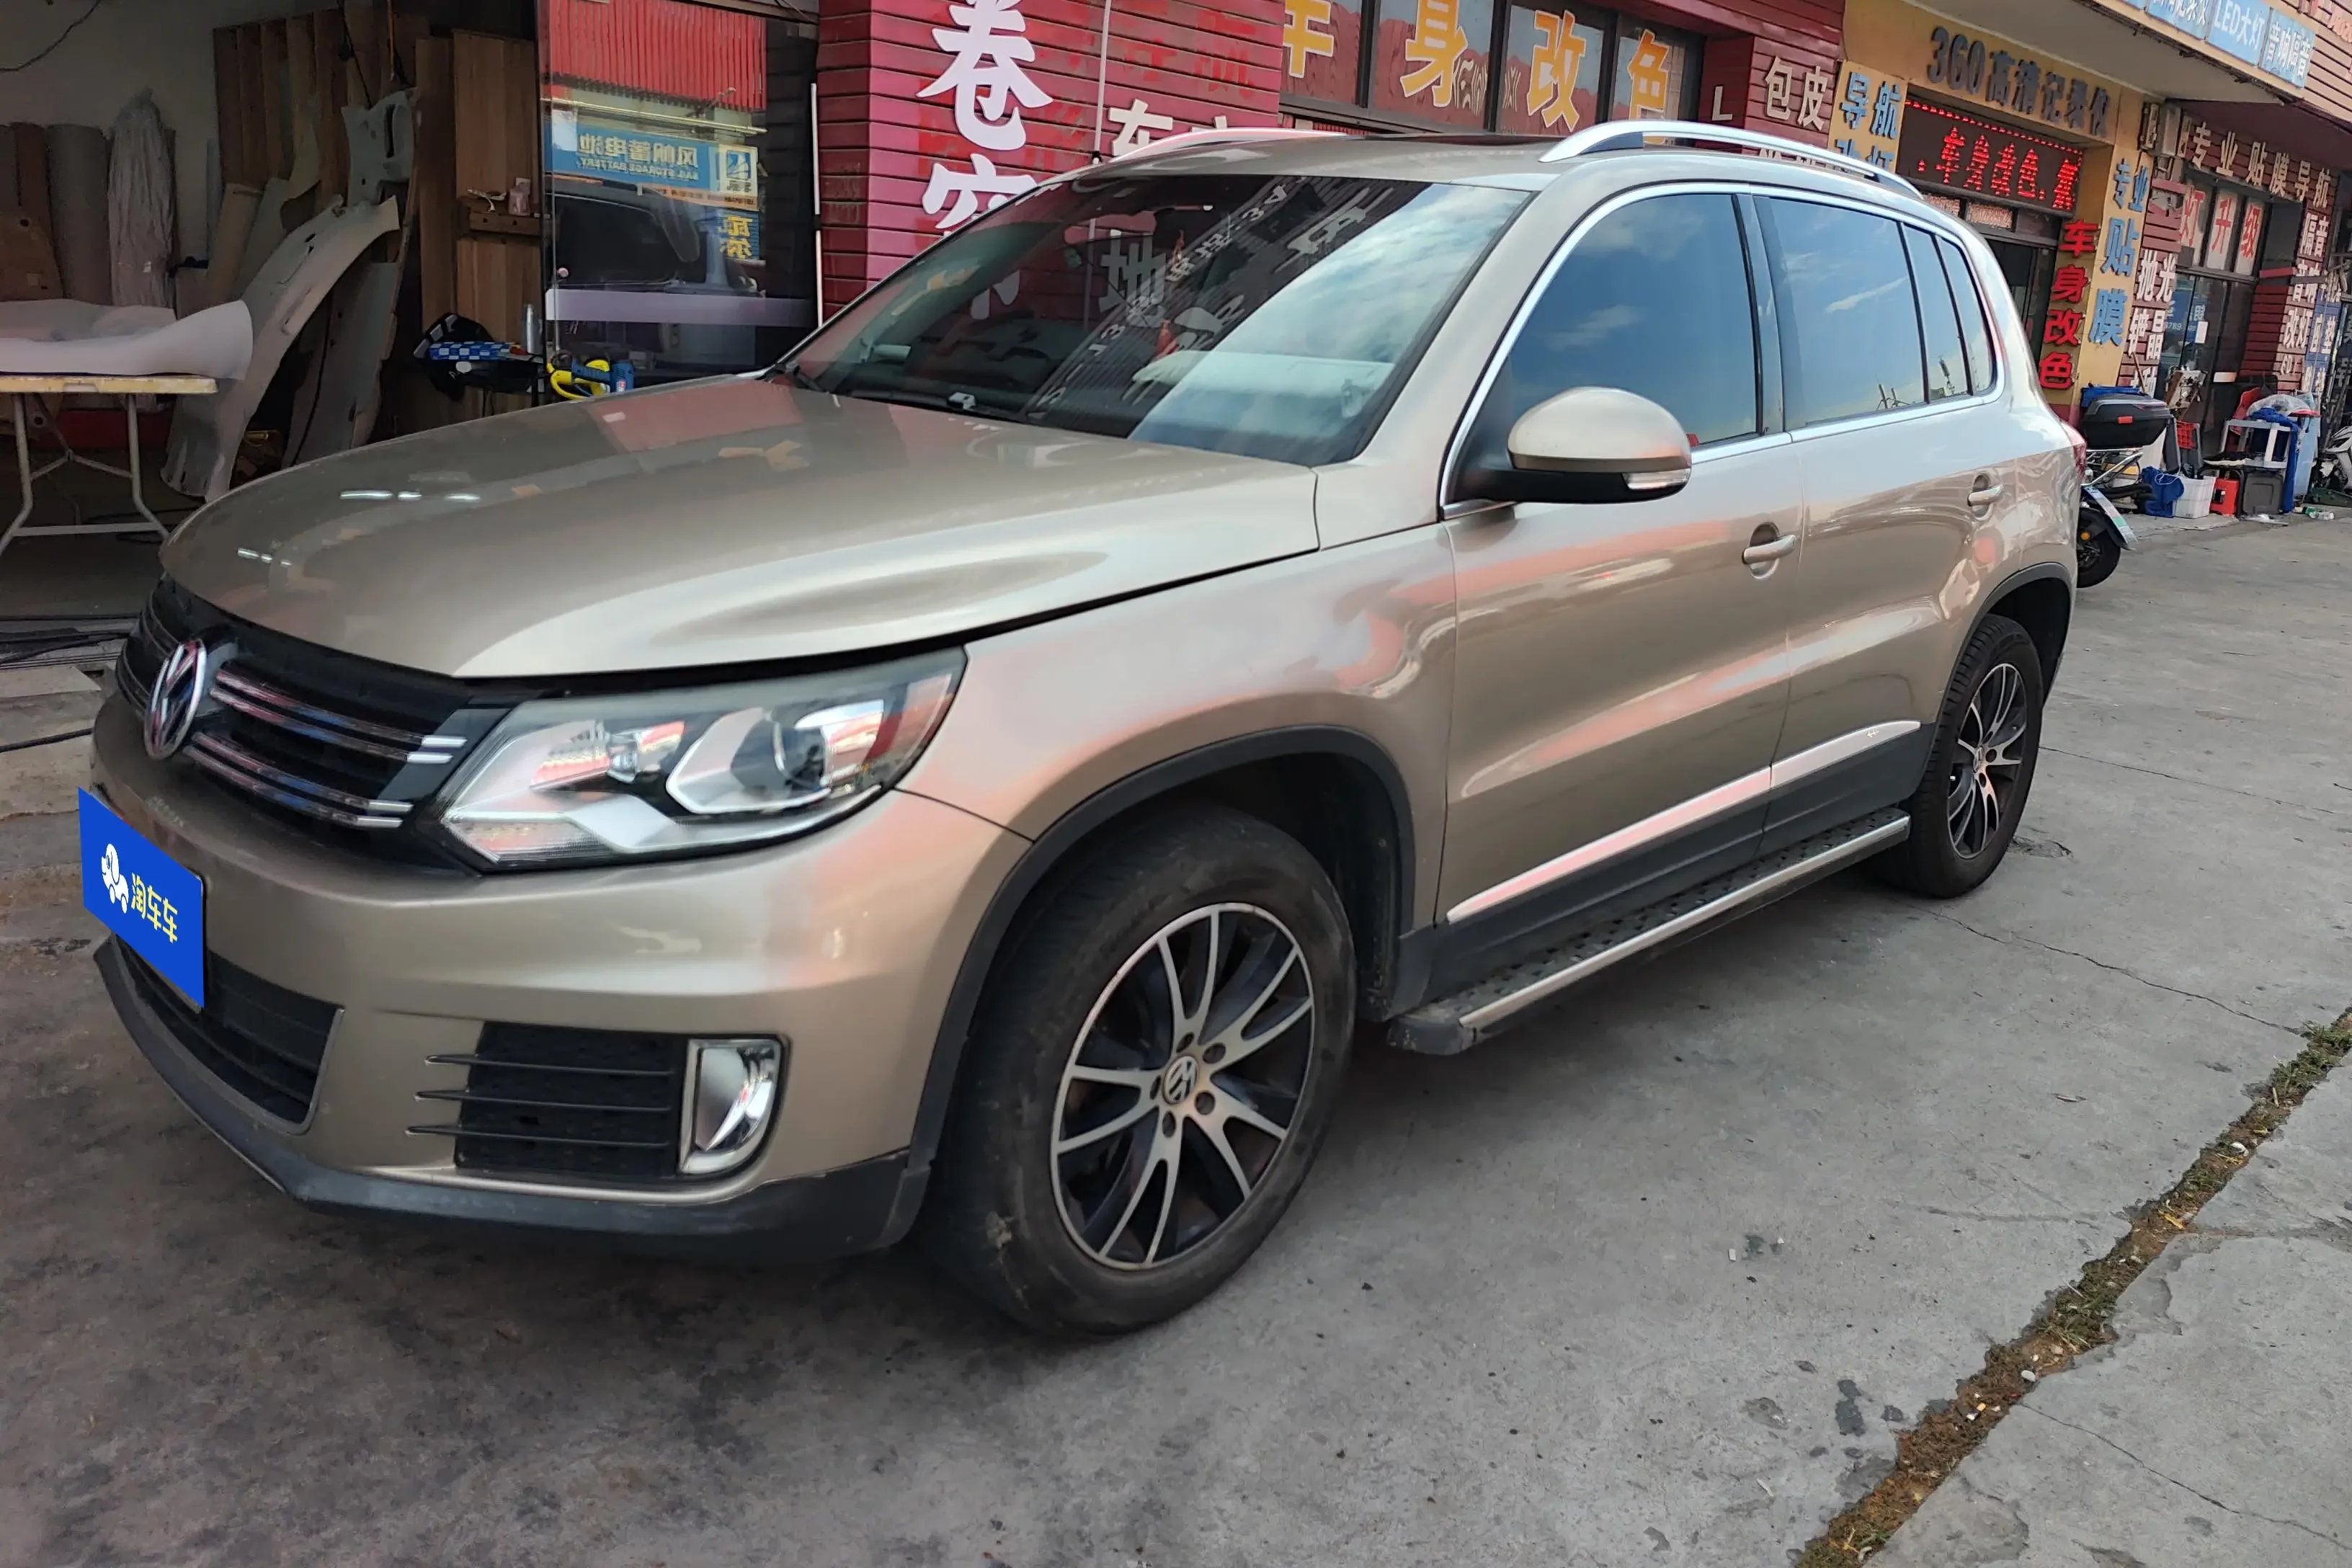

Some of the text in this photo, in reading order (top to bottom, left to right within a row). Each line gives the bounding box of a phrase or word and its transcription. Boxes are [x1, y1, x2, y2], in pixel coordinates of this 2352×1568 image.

[1765, 57, 1828, 131] 包皮
[1840, 71, 1902, 139] 导航
[2192, 121, 2330, 208] 专业贴膜导航
[2039, 218, 2100, 391] 车身改色
[2136, 249, 2177, 303] 抛光
